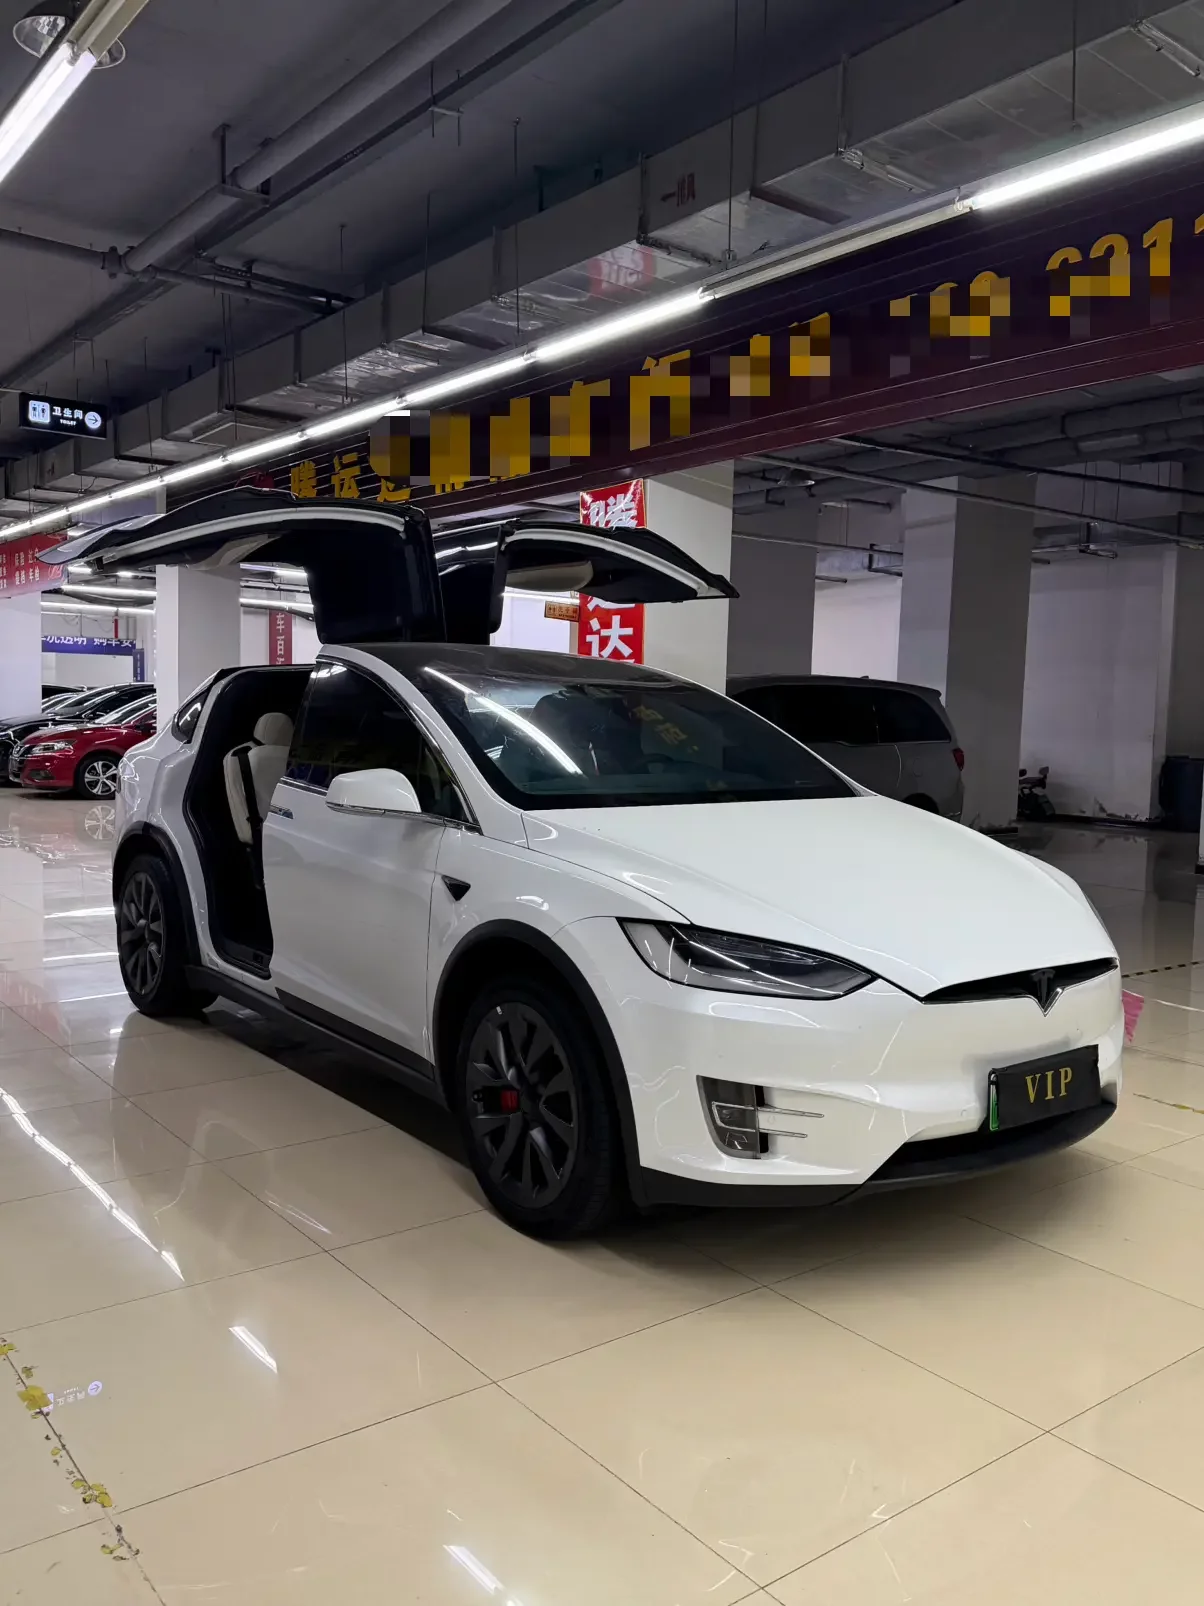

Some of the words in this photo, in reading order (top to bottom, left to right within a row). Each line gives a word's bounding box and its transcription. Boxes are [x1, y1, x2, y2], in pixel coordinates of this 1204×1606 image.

[52, 406, 83, 419] 卫生间
[1025, 1067, 1073, 1103] VIP
